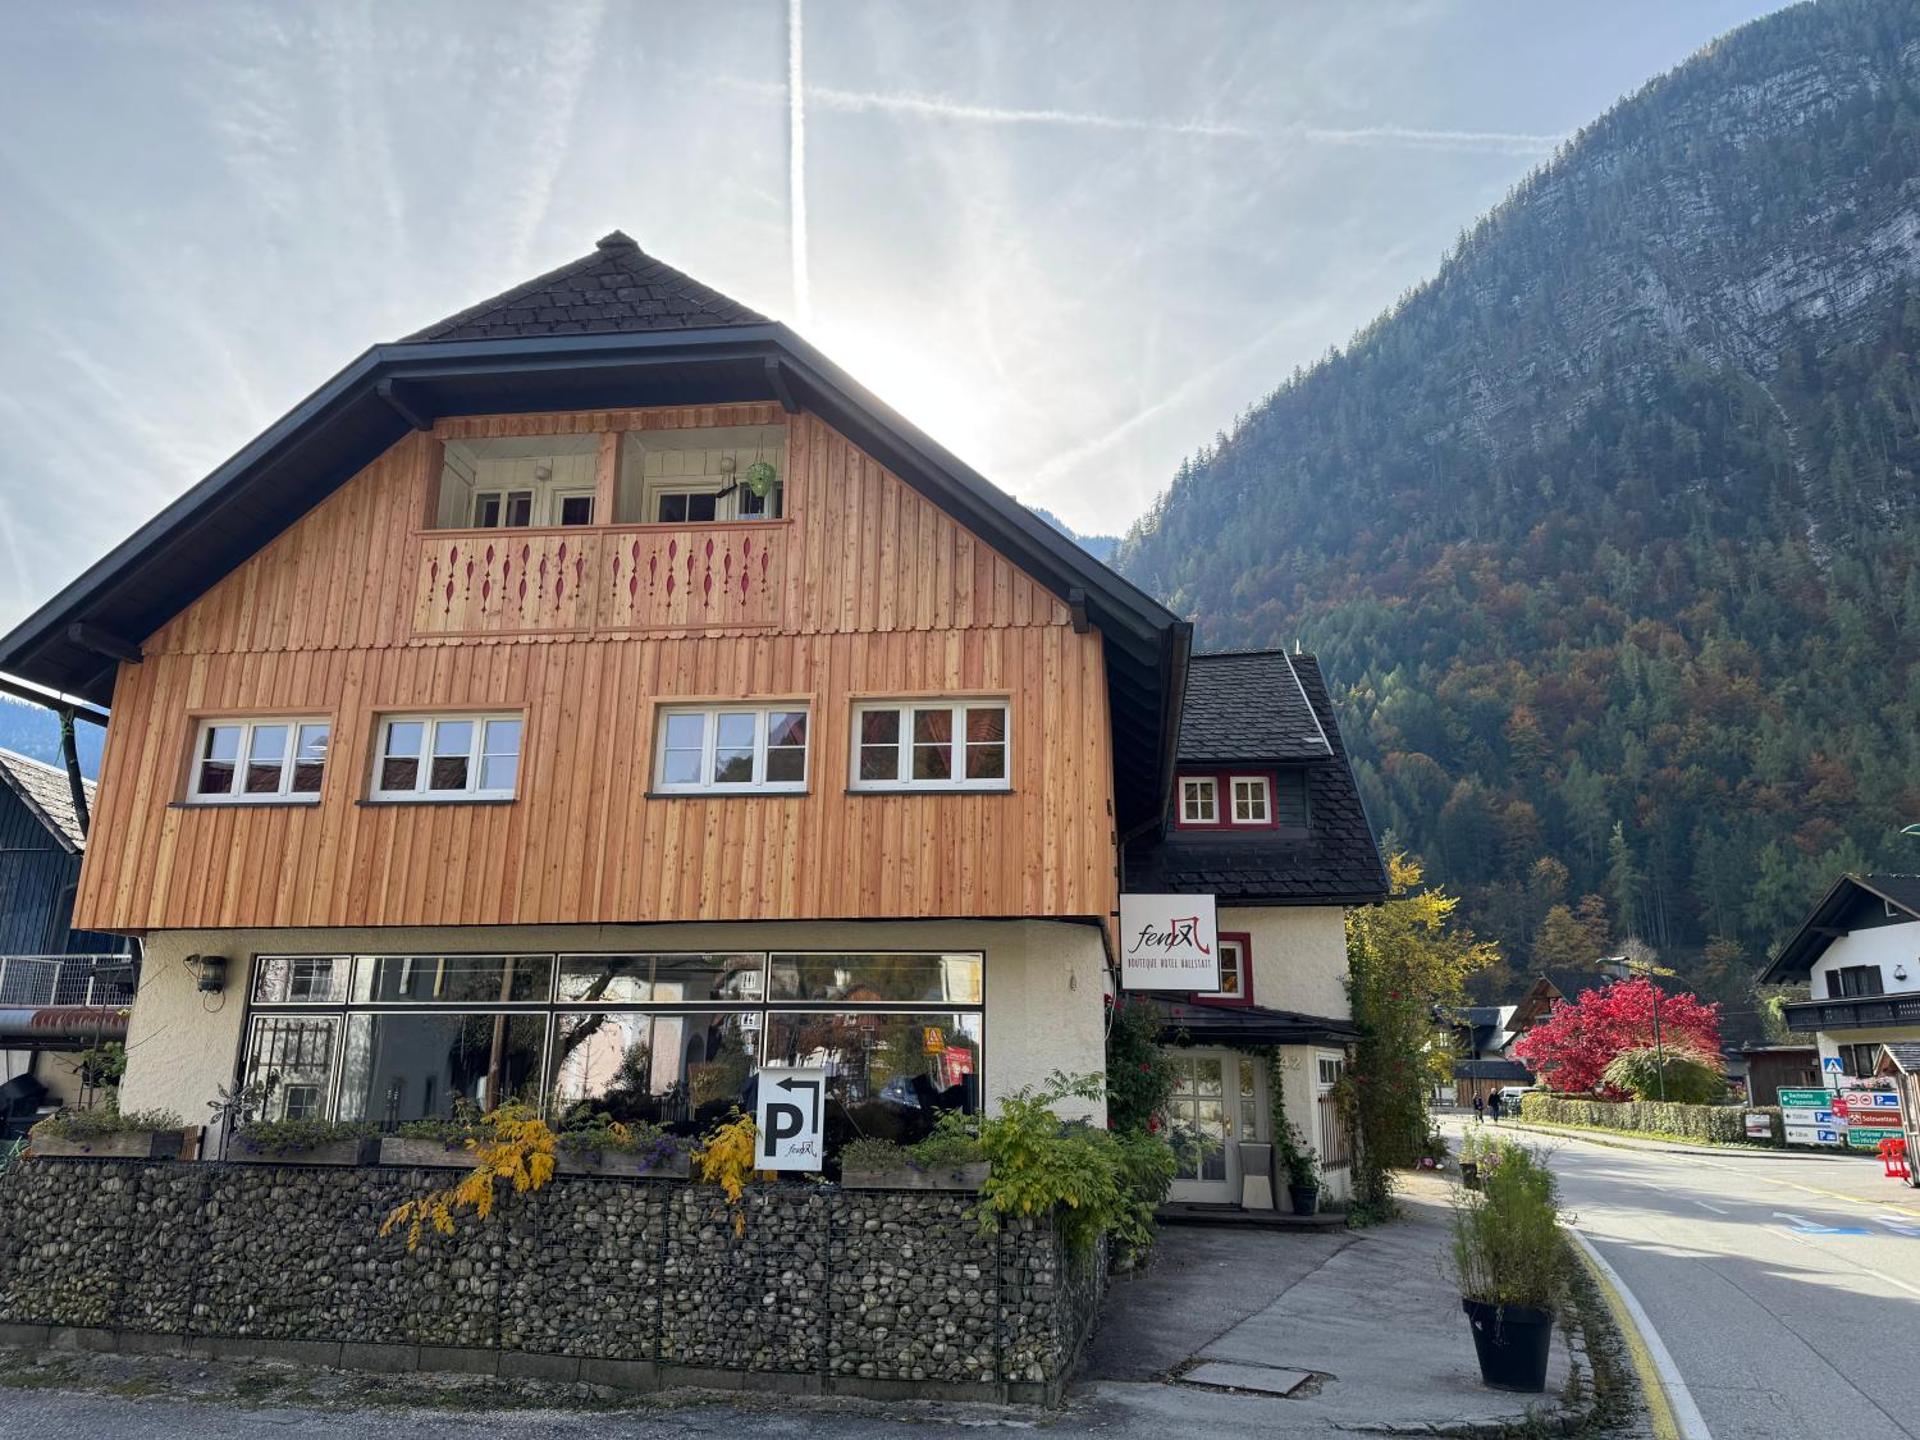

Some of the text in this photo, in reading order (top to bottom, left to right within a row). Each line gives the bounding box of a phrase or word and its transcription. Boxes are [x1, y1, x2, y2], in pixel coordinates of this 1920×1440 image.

[1161, 958, 1177, 969] HOTEL
[1876, 1096, 1884, 1105] P
[1817, 1113, 1824, 1121] P
[764, 1103, 804, 1156] P
